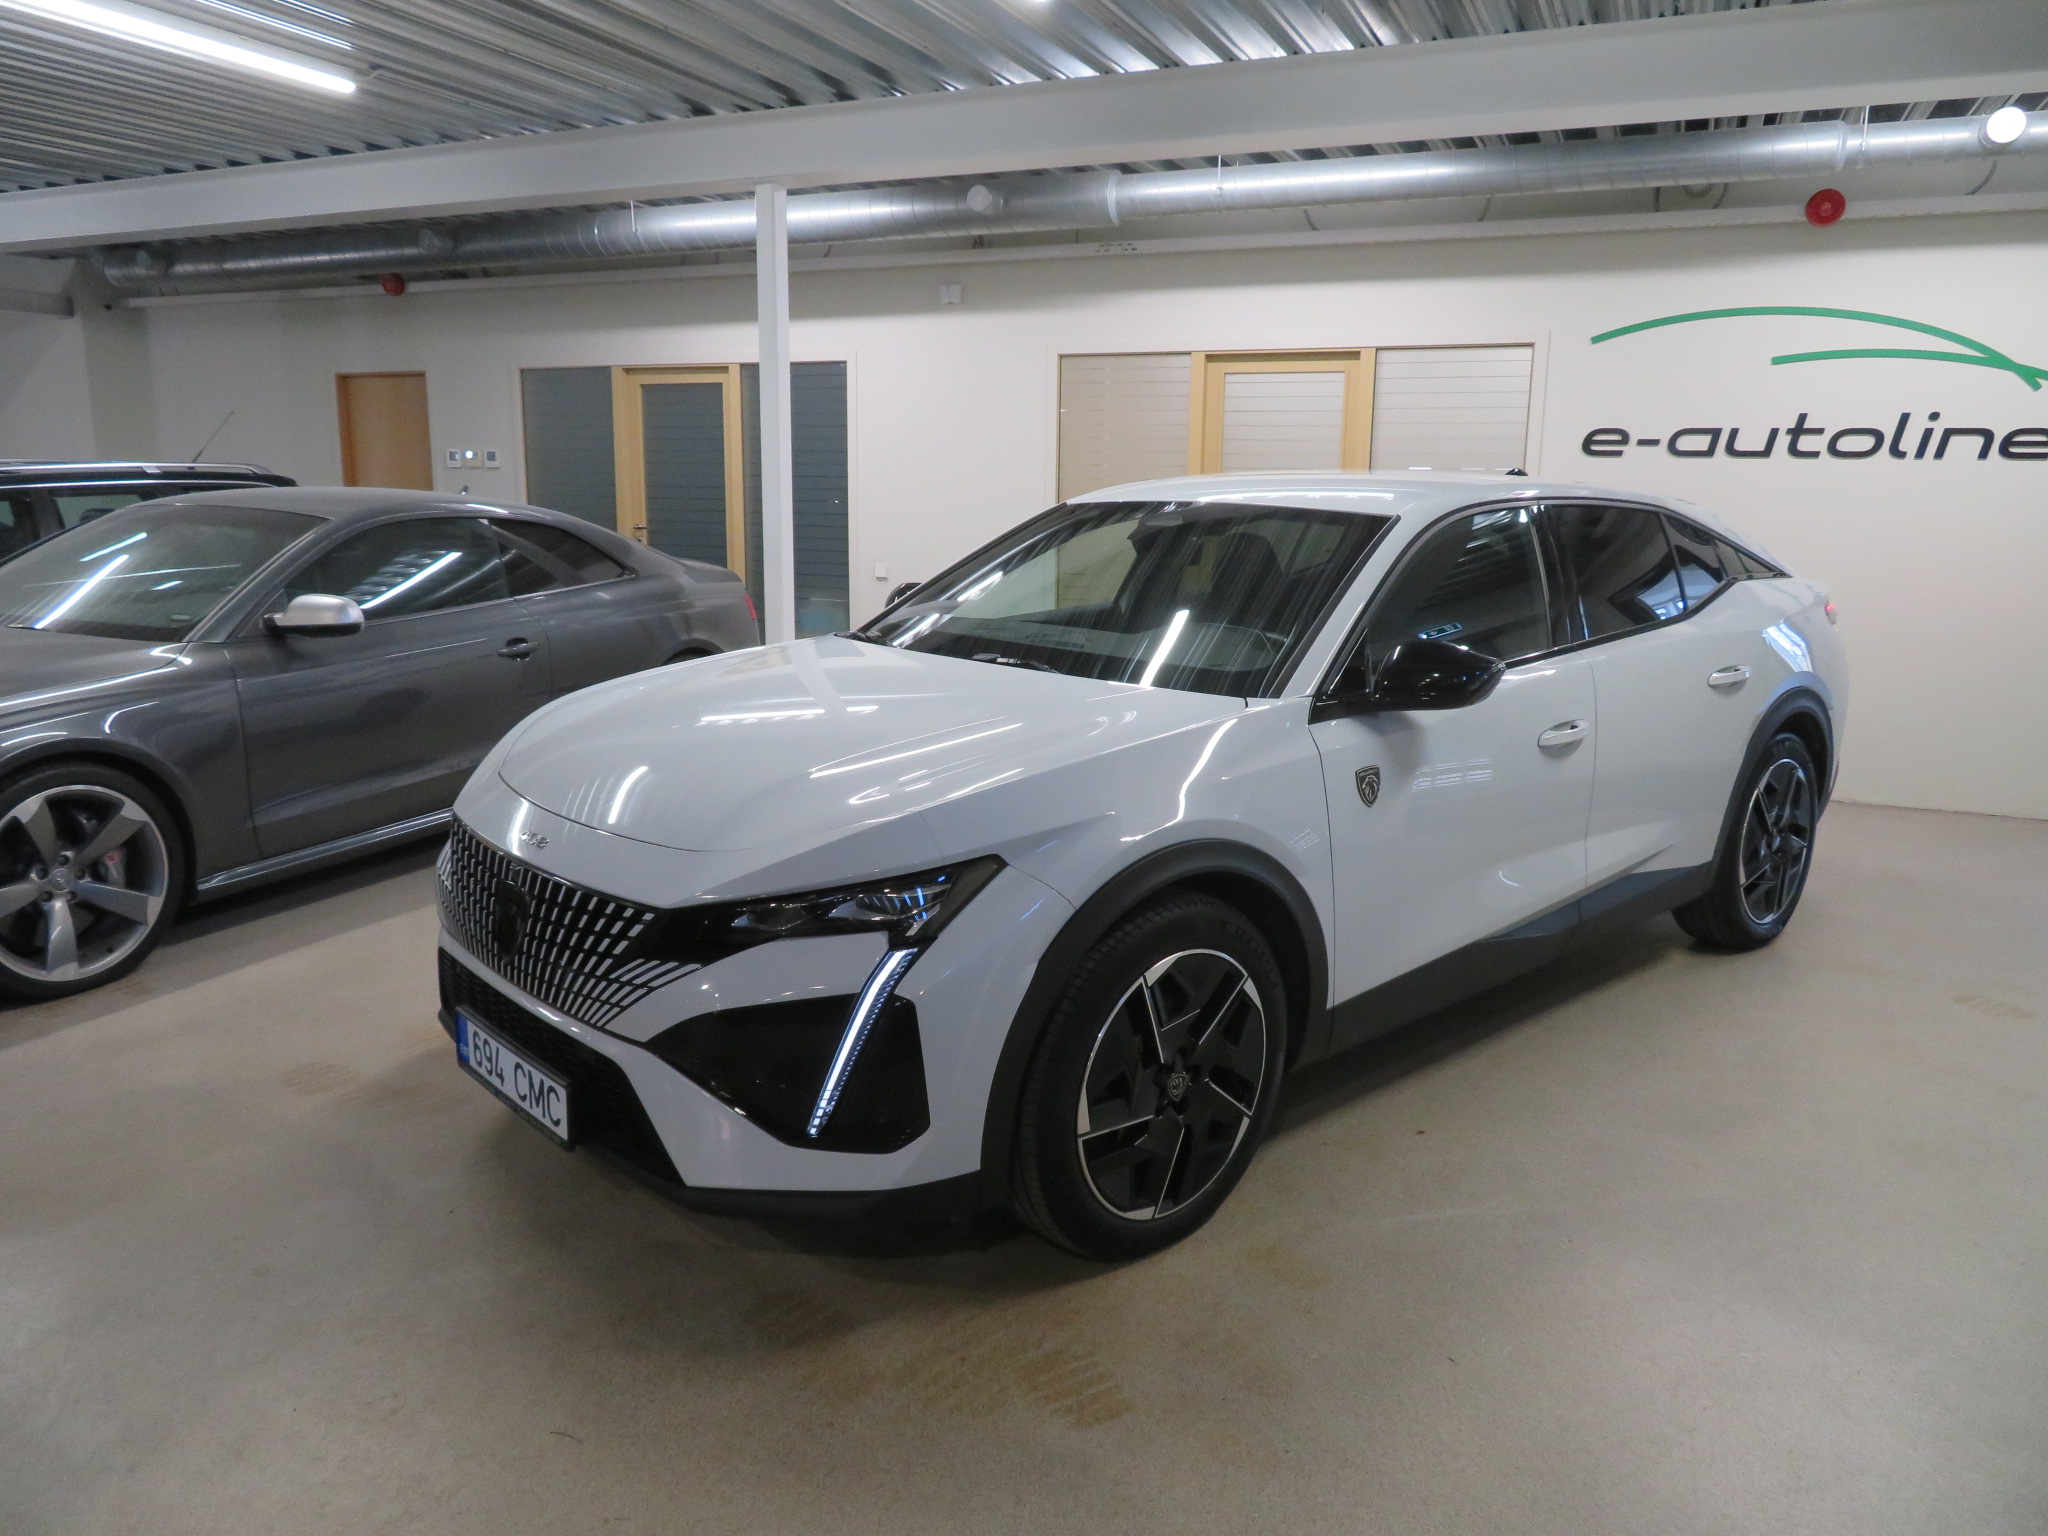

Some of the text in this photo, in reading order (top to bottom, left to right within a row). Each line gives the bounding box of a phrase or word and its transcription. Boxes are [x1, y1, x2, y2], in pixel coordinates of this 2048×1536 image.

[1581, 411, 2048, 461] e-autoline
[472, 1029, 562, 1128] 694 CMC
